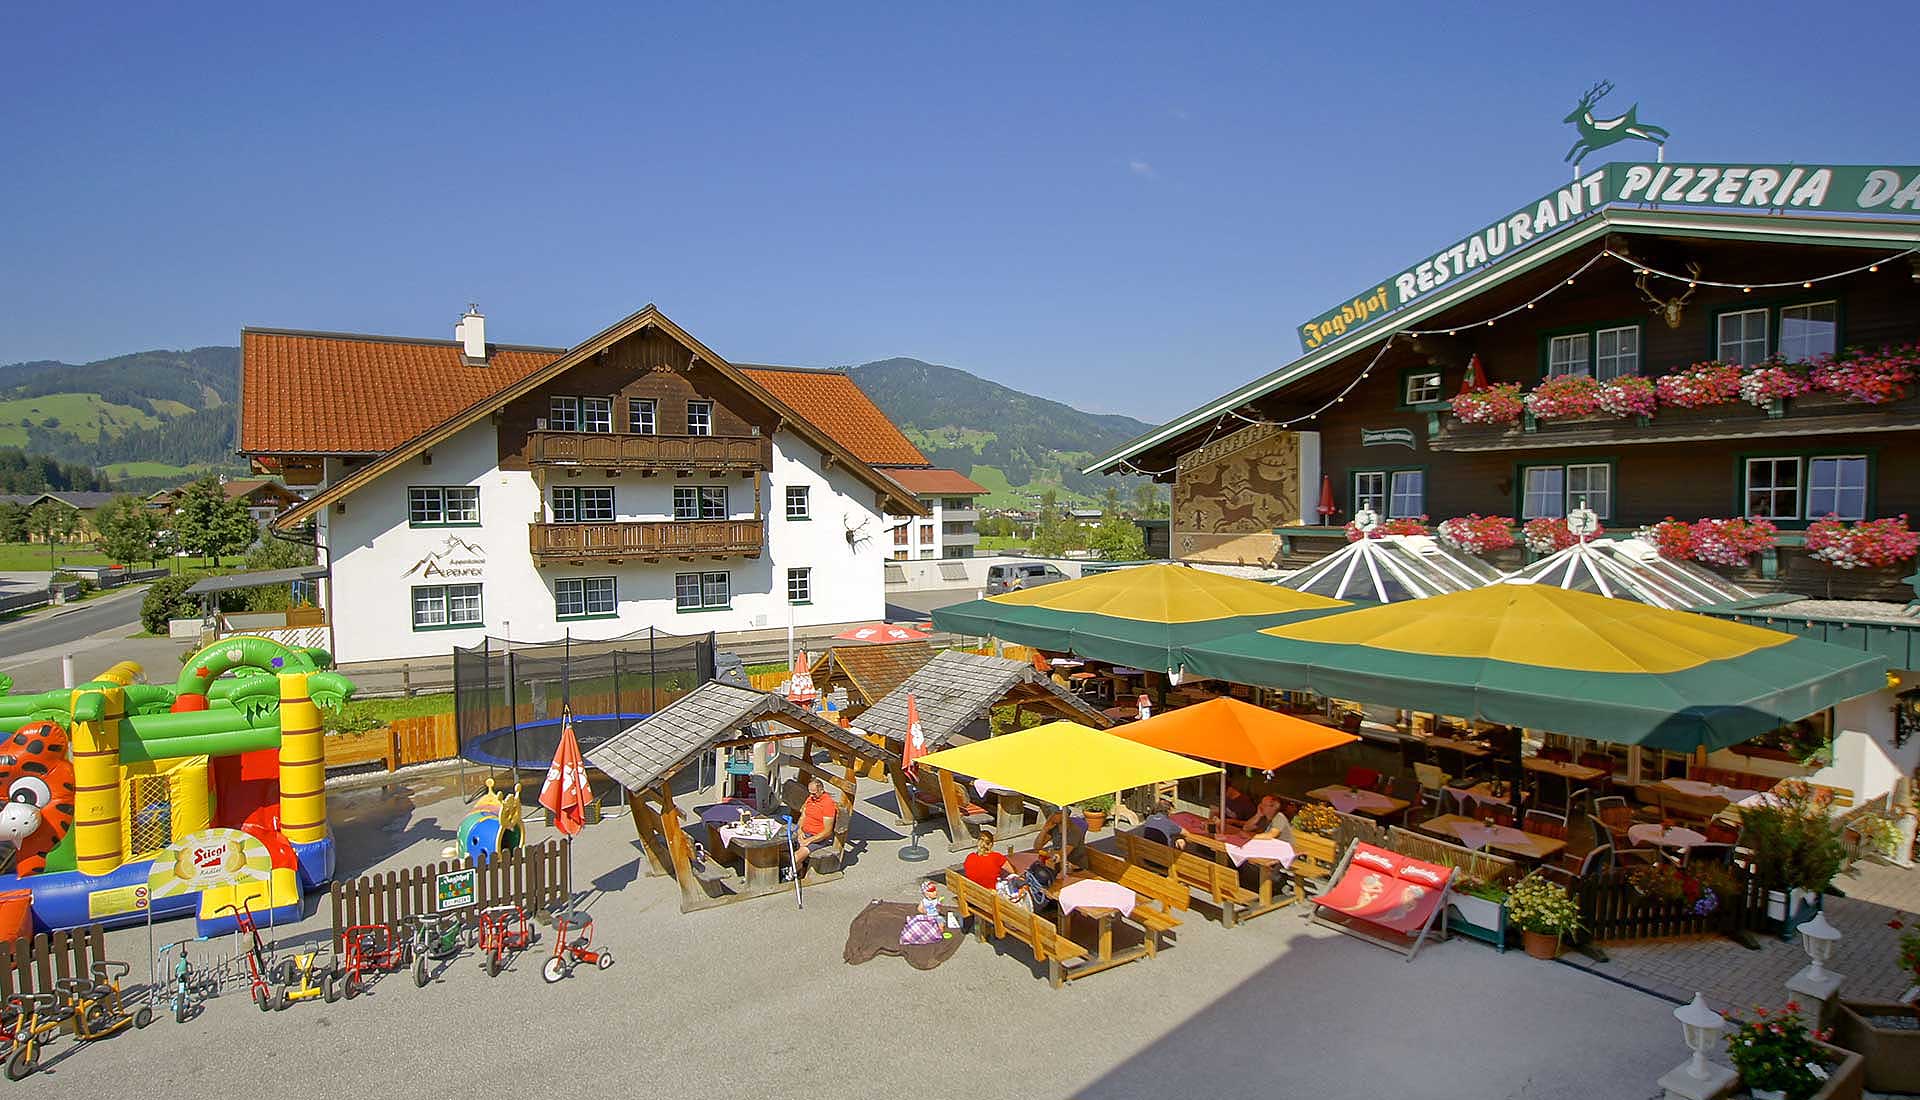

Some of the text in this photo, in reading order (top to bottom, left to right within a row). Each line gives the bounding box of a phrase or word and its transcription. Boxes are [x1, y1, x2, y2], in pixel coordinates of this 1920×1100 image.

[1619, 166, 1832, 206] PIZZERIA
[1303, 170, 1605, 348] Jagdhof RESTAURANT
[194, 844, 227, 865] Stiegl
